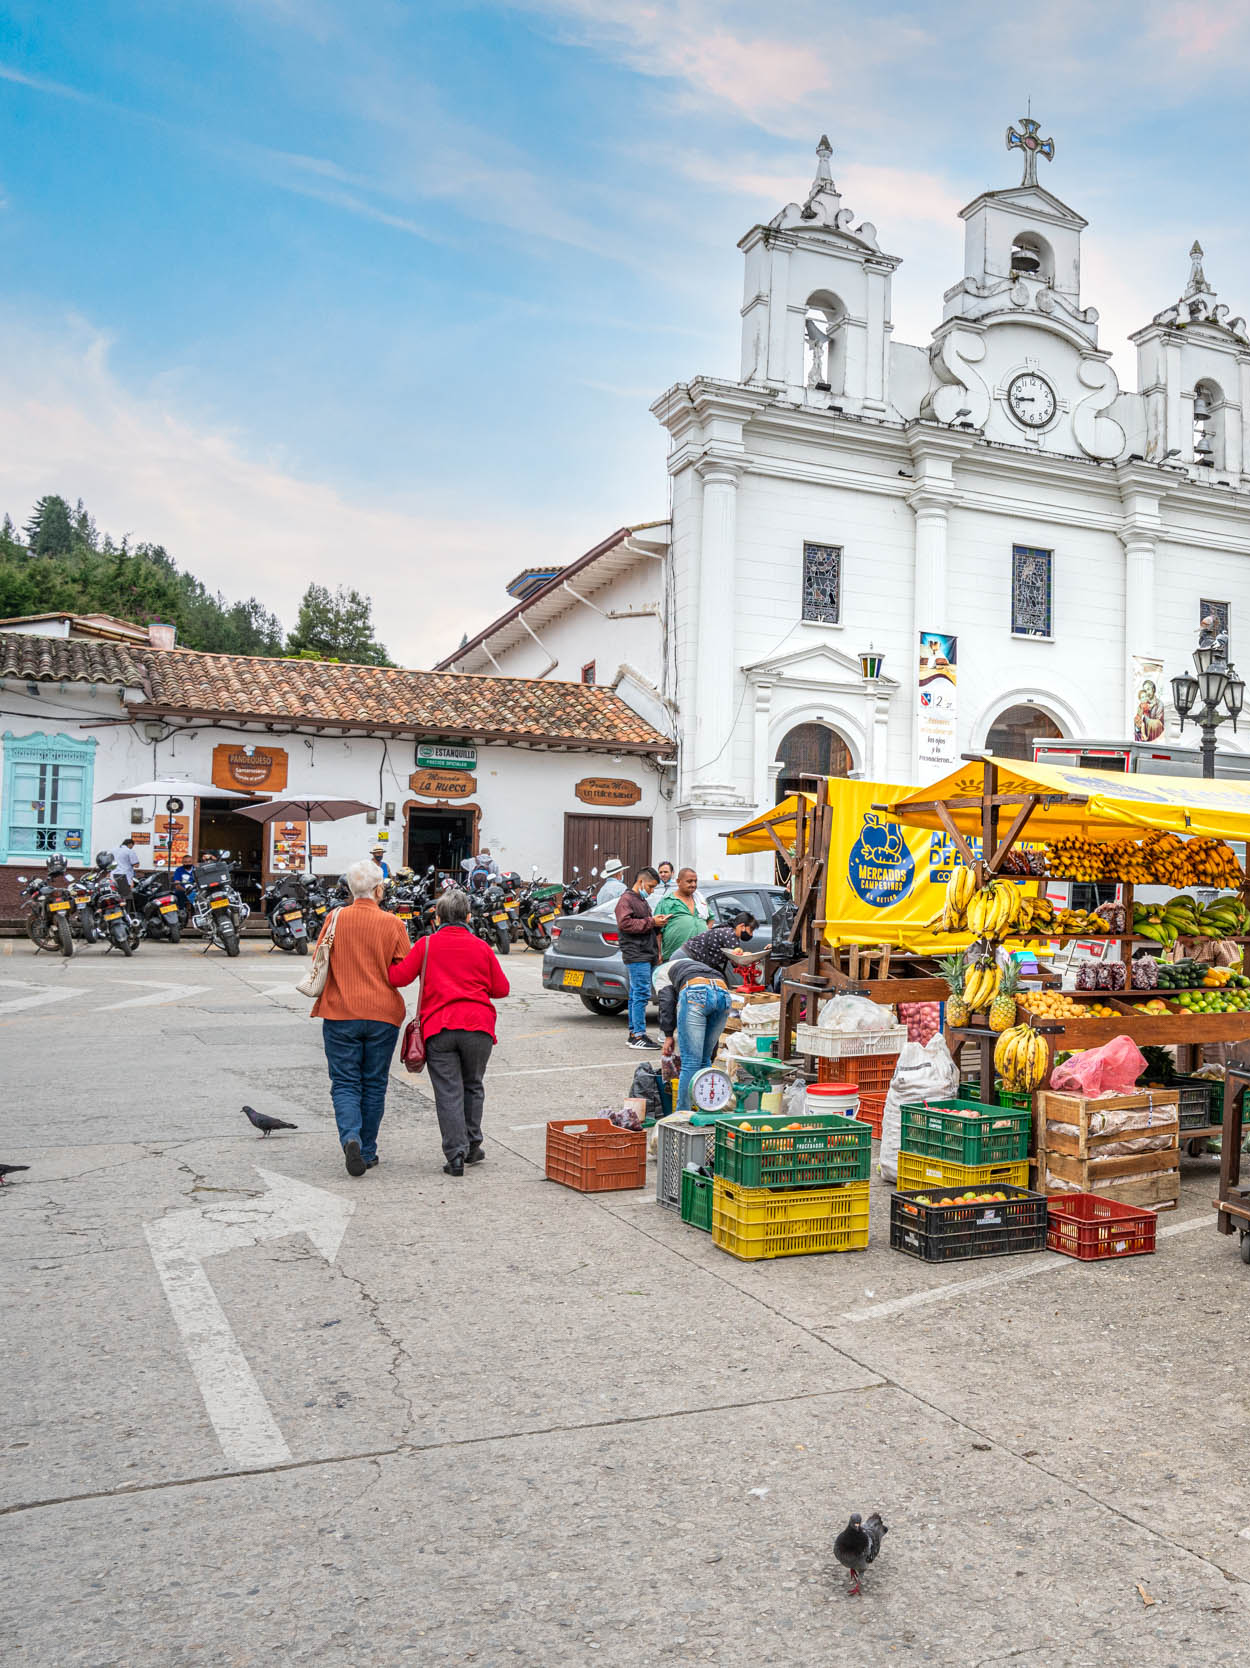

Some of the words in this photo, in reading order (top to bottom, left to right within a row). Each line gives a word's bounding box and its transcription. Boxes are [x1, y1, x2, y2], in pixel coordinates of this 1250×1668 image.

[230, 754, 271, 764] PANDEQUESO
[435, 748, 475, 759] ESTANQUILLO
[929, 850, 951, 866] DE
[859, 864, 907, 882] MERCADOS
[861, 880, 903, 891] CAMPESINOS
